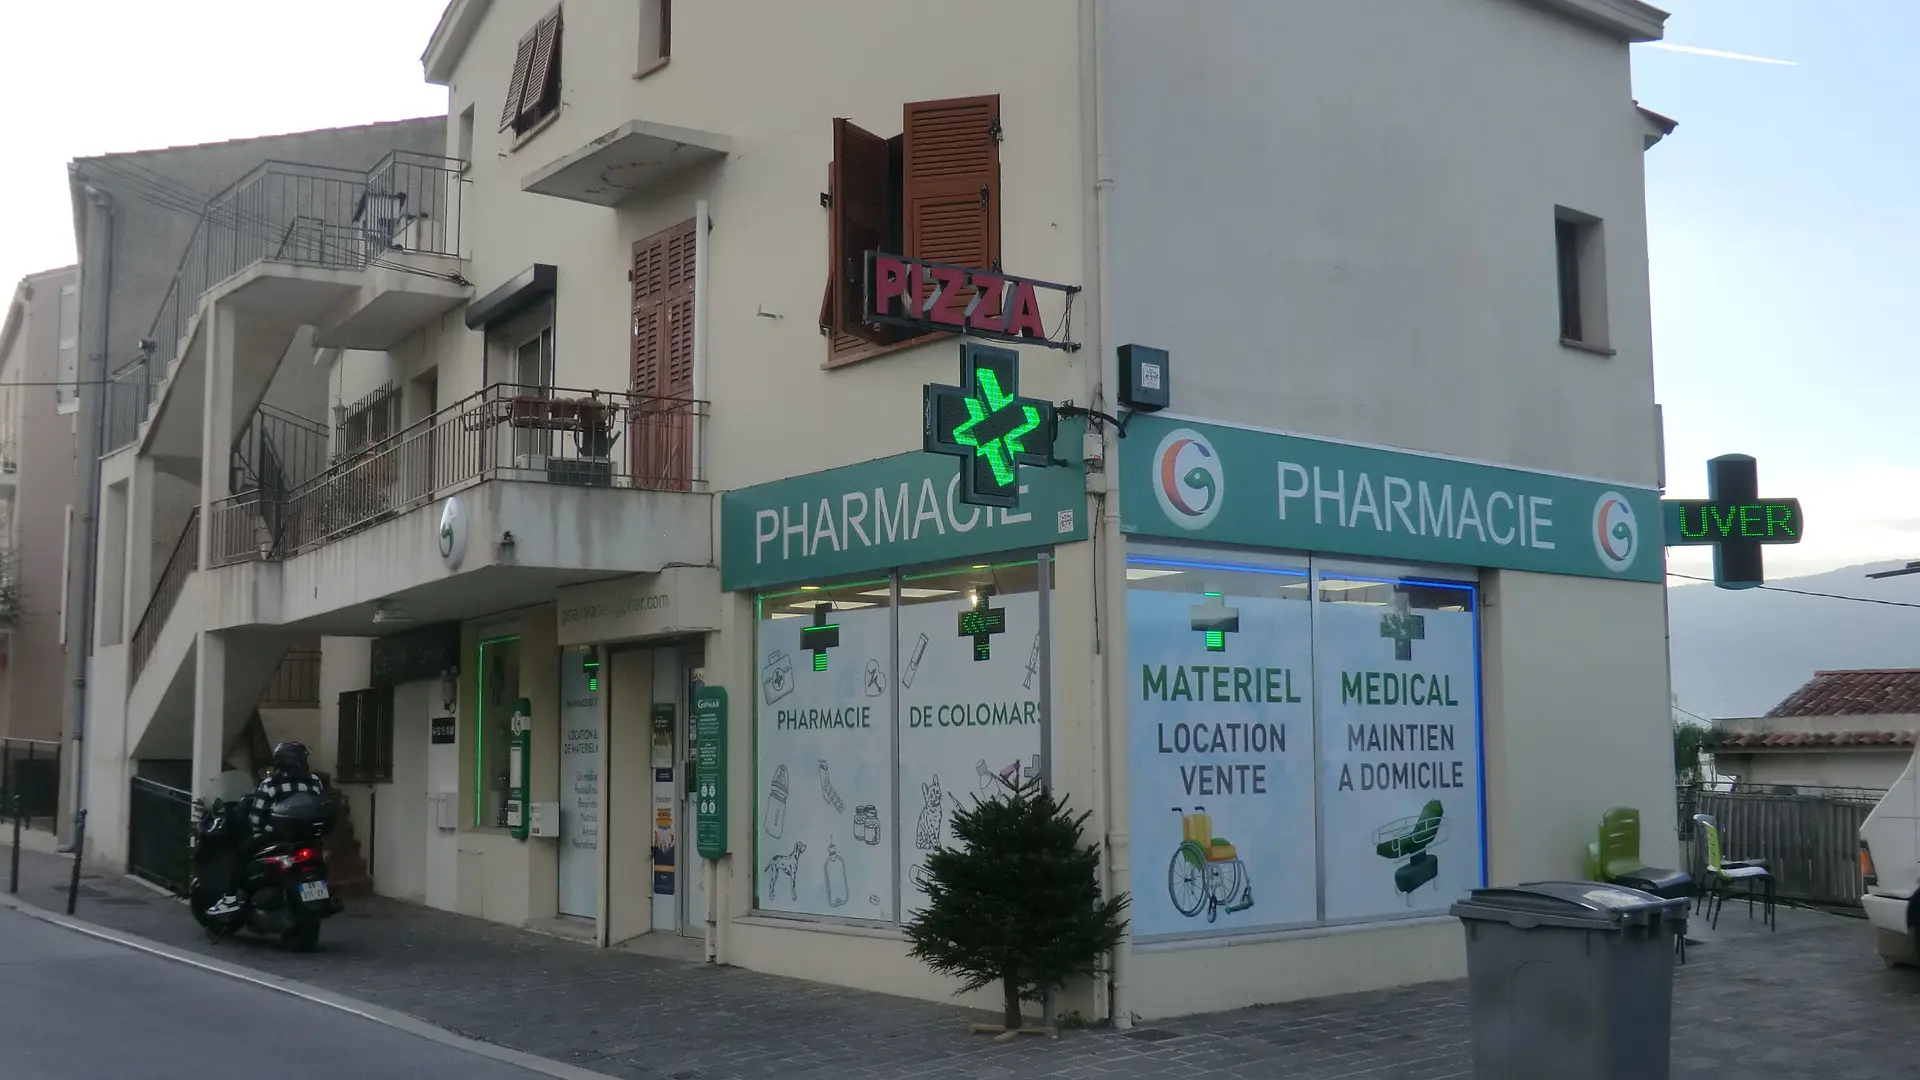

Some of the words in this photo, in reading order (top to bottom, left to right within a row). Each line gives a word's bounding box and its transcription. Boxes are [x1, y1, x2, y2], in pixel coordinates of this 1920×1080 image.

[876, 256, 1046, 339] PIZZA
[1276, 461, 1555, 550] PHARMACIE
[1679, 505, 1796, 537] UVER
[1141, 664, 1301, 704] MATERIEL
[1341, 671, 1459, 707] MEDICAL
[777, 706, 871, 730] PHARMACIE
[909, 705, 933, 728] DE
[1157, 722, 1286, 754] LOCATION
[1347, 724, 1455, 752] MAINTIEN
[1180, 764, 1267, 796] VENTE
[1338, 764, 1354, 792] A
[1361, 761, 1464, 791] DOMICILE
